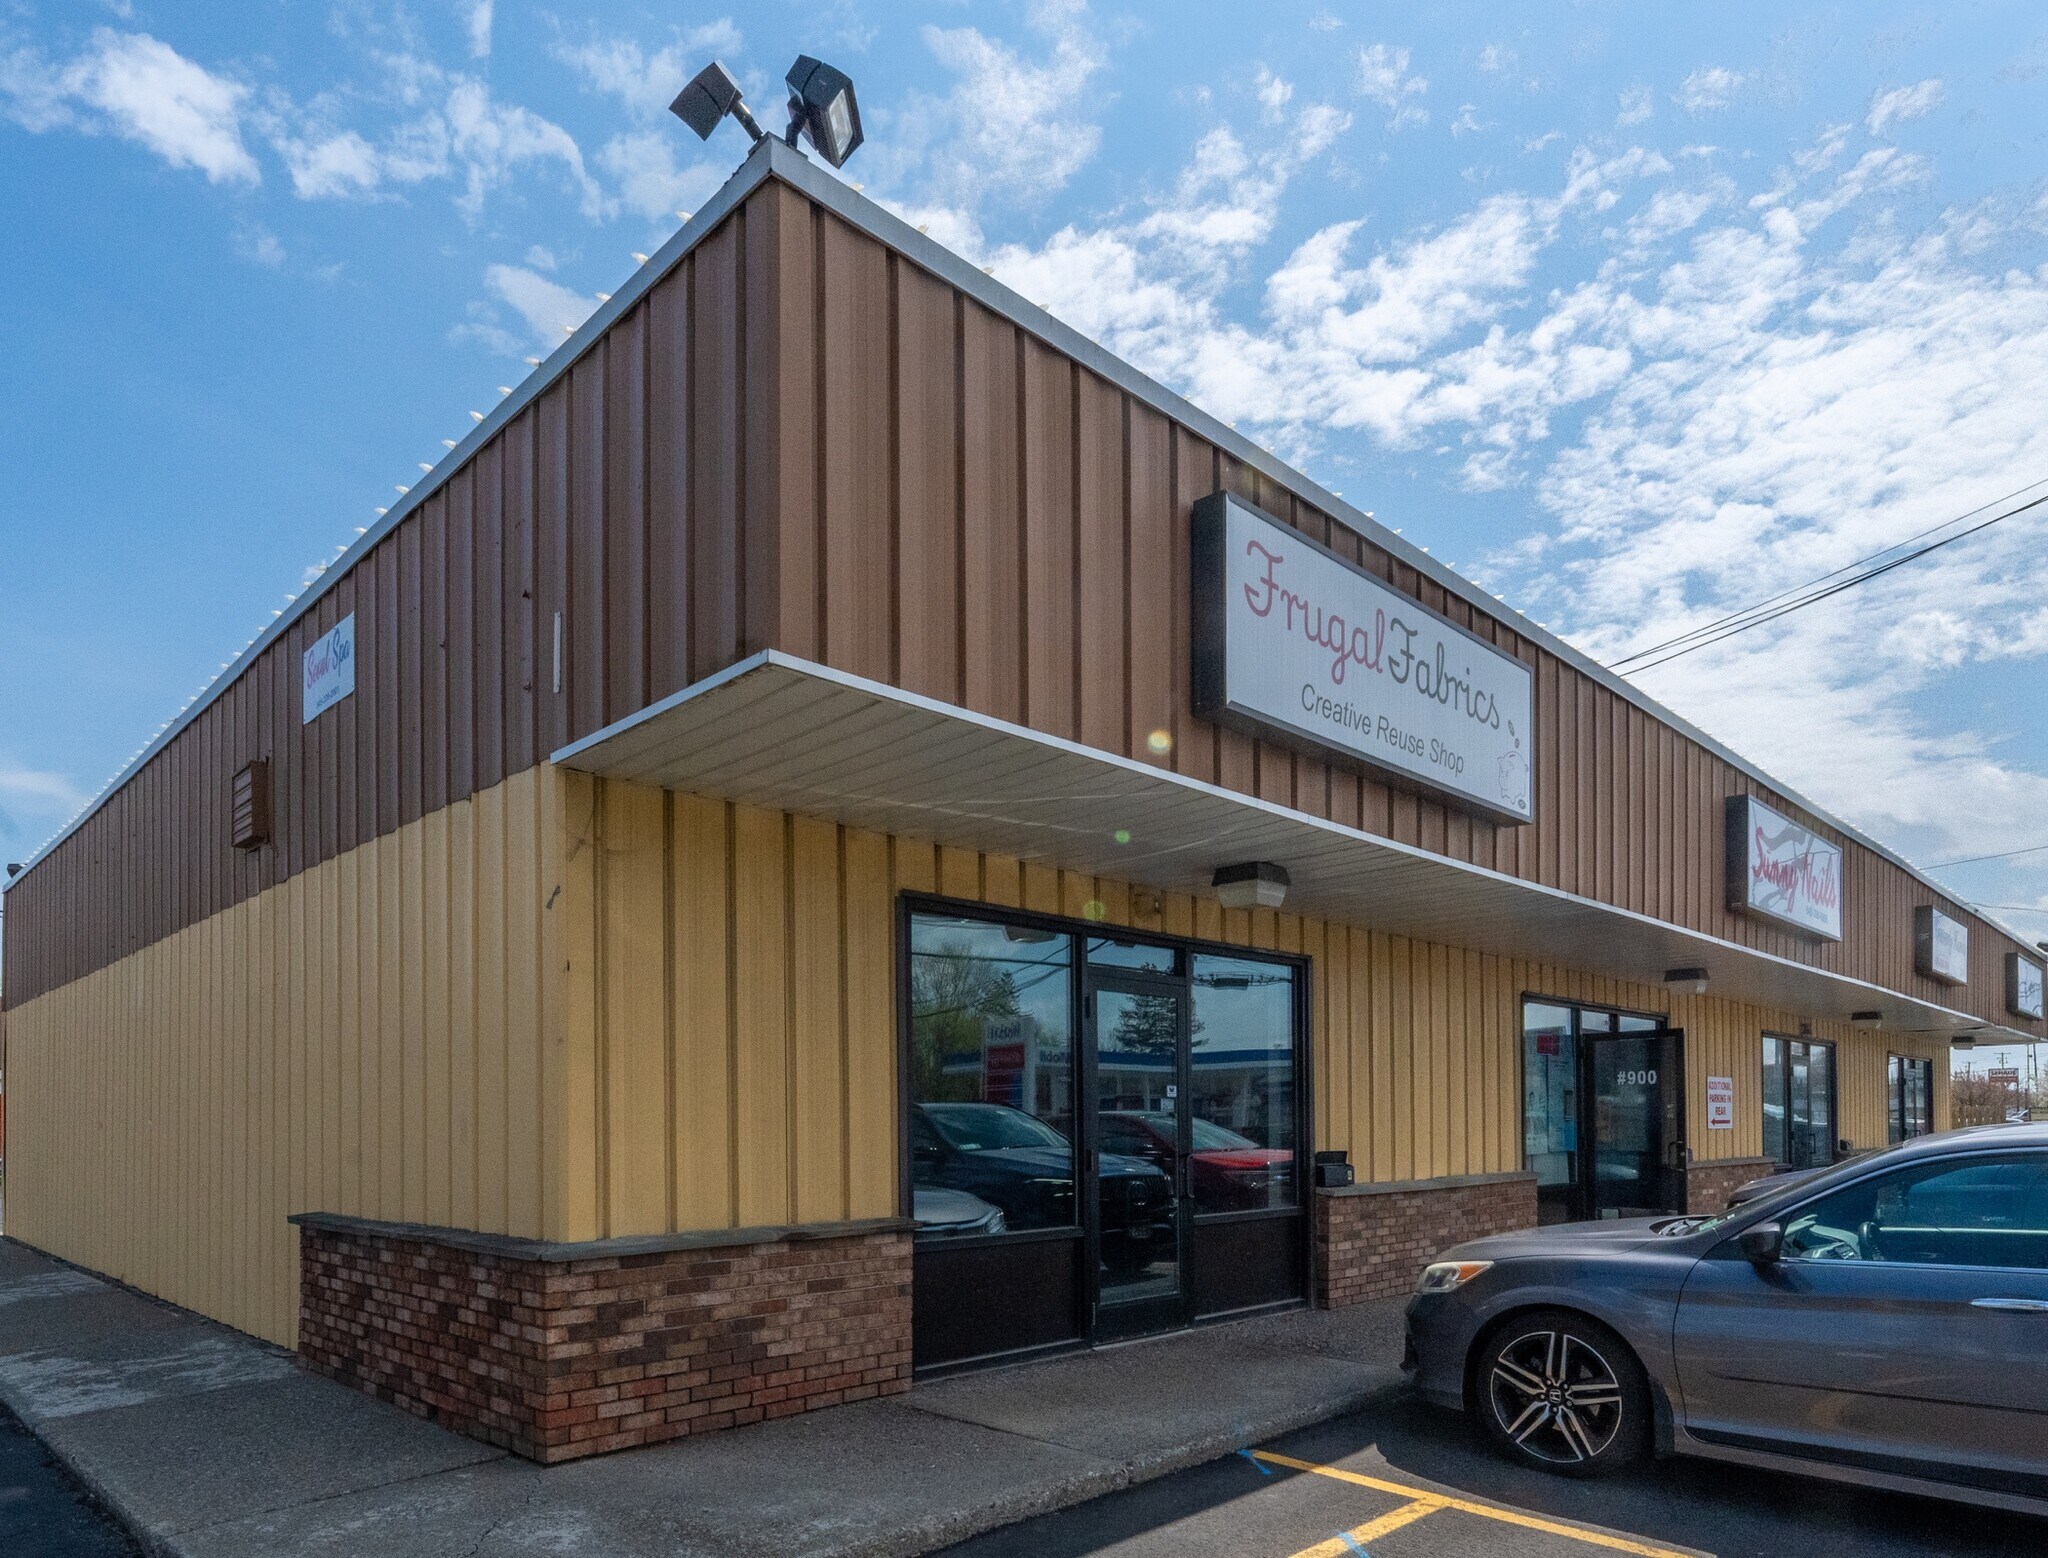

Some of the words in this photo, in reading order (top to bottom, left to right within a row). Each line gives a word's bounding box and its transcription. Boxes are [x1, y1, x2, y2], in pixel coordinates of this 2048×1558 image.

[1244, 540, 1385, 685] Frugal
[1388, 618, 1501, 730] Fabrics
[332, 627, 351, 678] Spa
[1302, 684, 1371, 735] Creative
[1376, 715, 1425, 757] Reuse
[1430, 738, 1464, 778] Shop
[1752, 826, 1799, 914] Sunny
[1801, 852, 1837, 909] Nails
[1617, 1070, 1657, 1085] #900
[1709, 1081, 1732, 1090] ADDITIONAL
[1709, 1093, 1726, 1103] PARKING
[1727, 1094, 1732, 1103] IN
[1715, 1106, 1726, 1116] REAR
